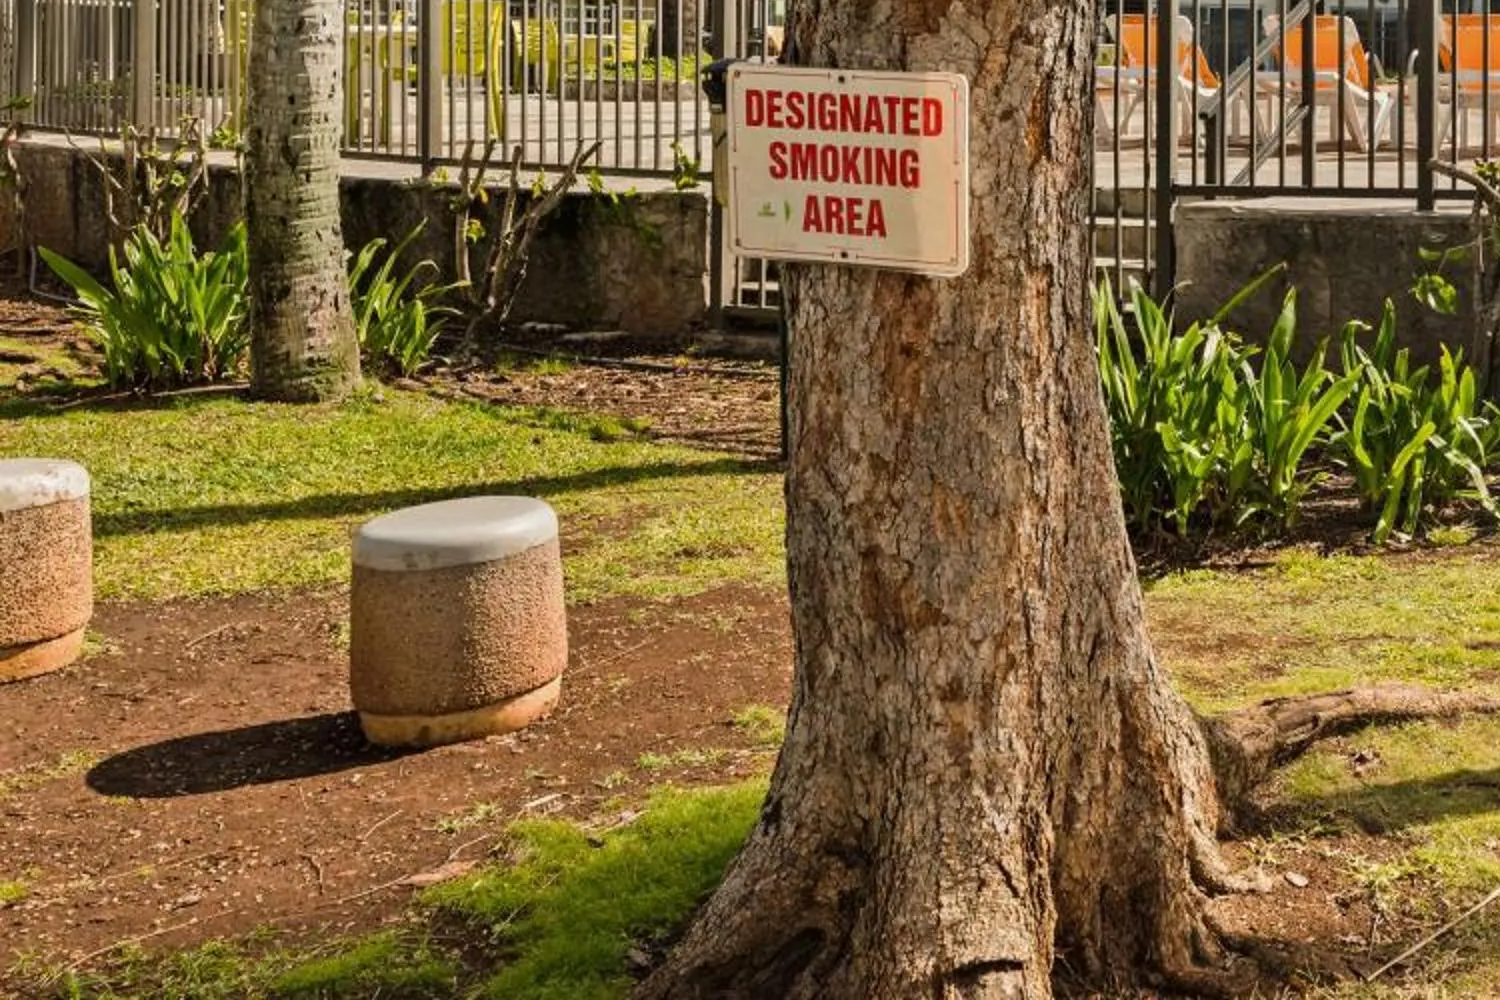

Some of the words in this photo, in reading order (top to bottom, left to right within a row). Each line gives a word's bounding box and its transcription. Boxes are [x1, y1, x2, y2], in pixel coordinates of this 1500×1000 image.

[745, 89, 943, 137] DESIGNATED
[769, 141, 920, 189] SMOKING
[802, 195, 887, 239] AREA
